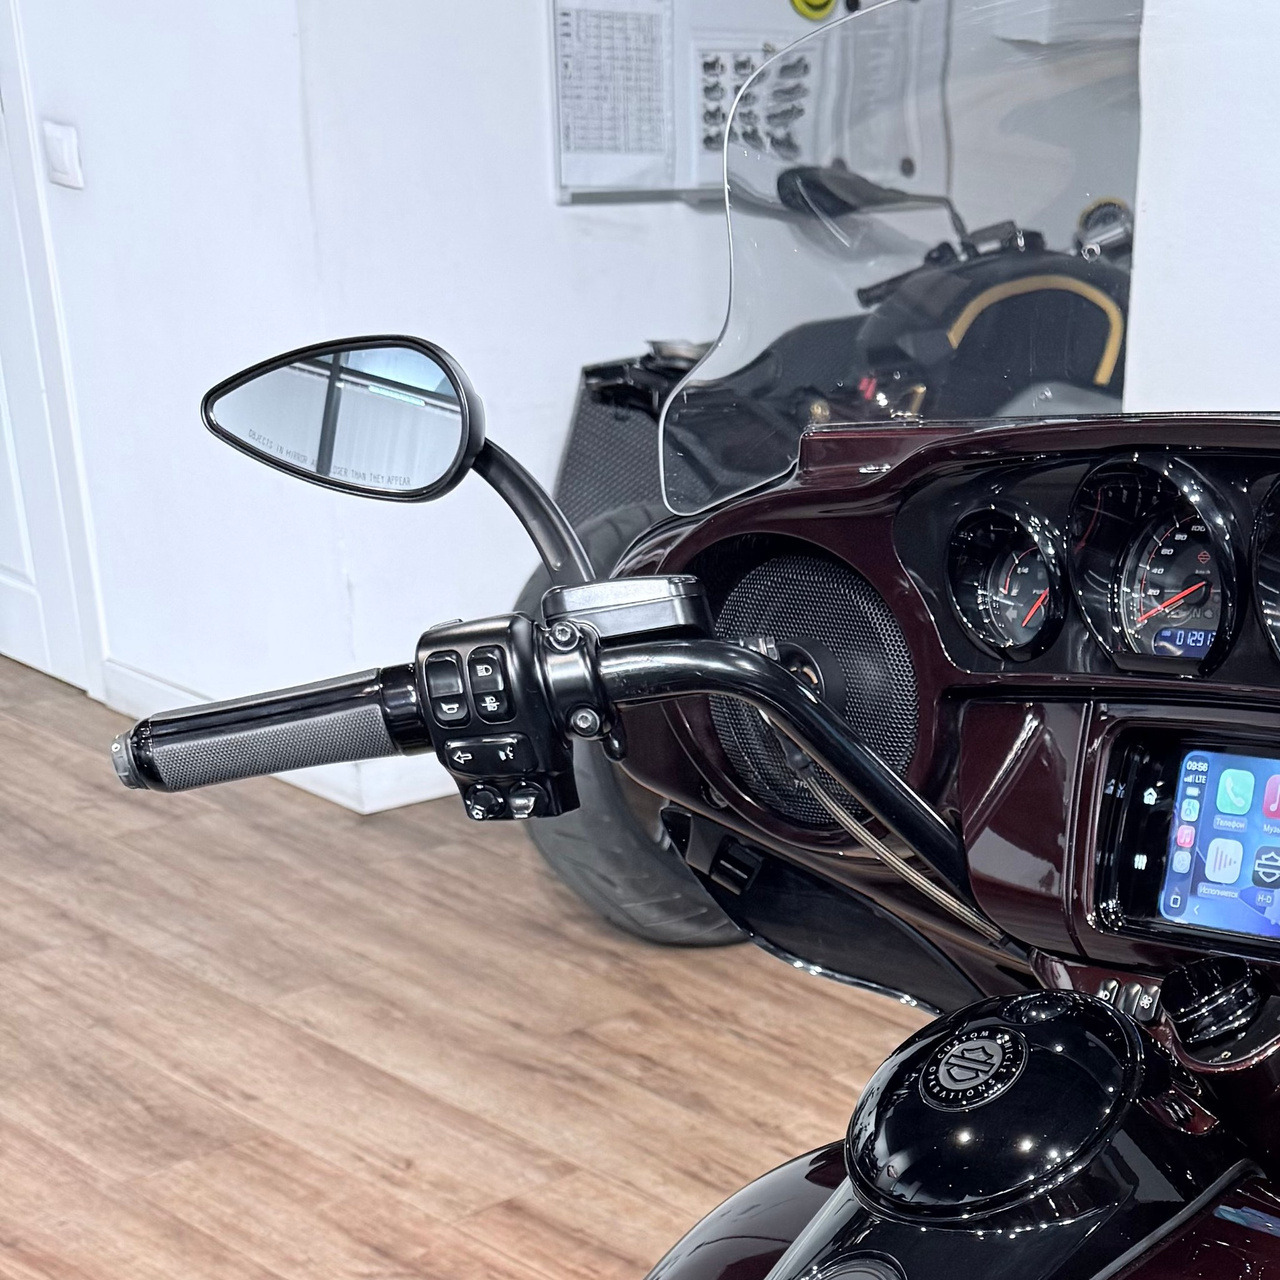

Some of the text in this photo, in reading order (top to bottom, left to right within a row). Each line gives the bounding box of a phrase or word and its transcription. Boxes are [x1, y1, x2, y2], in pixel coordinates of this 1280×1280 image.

[248, 428, 308, 464] OBJECTS IN MIRROR
[351, 469, 367, 482] THAN
[370, 472, 384, 484] THEY
[386, 475, 412, 487] APPEAR
[1160, 548, 1174, 556] 60
[1186, 760, 1208, 772] 09:56
[1195, 774, 1207, 784] LTE
[1215, 817, 1246, 829] Телефон
[1257, 893, 1272, 904] H-D
[937, 1030, 989, 1059] CUSTOM
[927, 1066, 996, 1099] OPERATIONS
